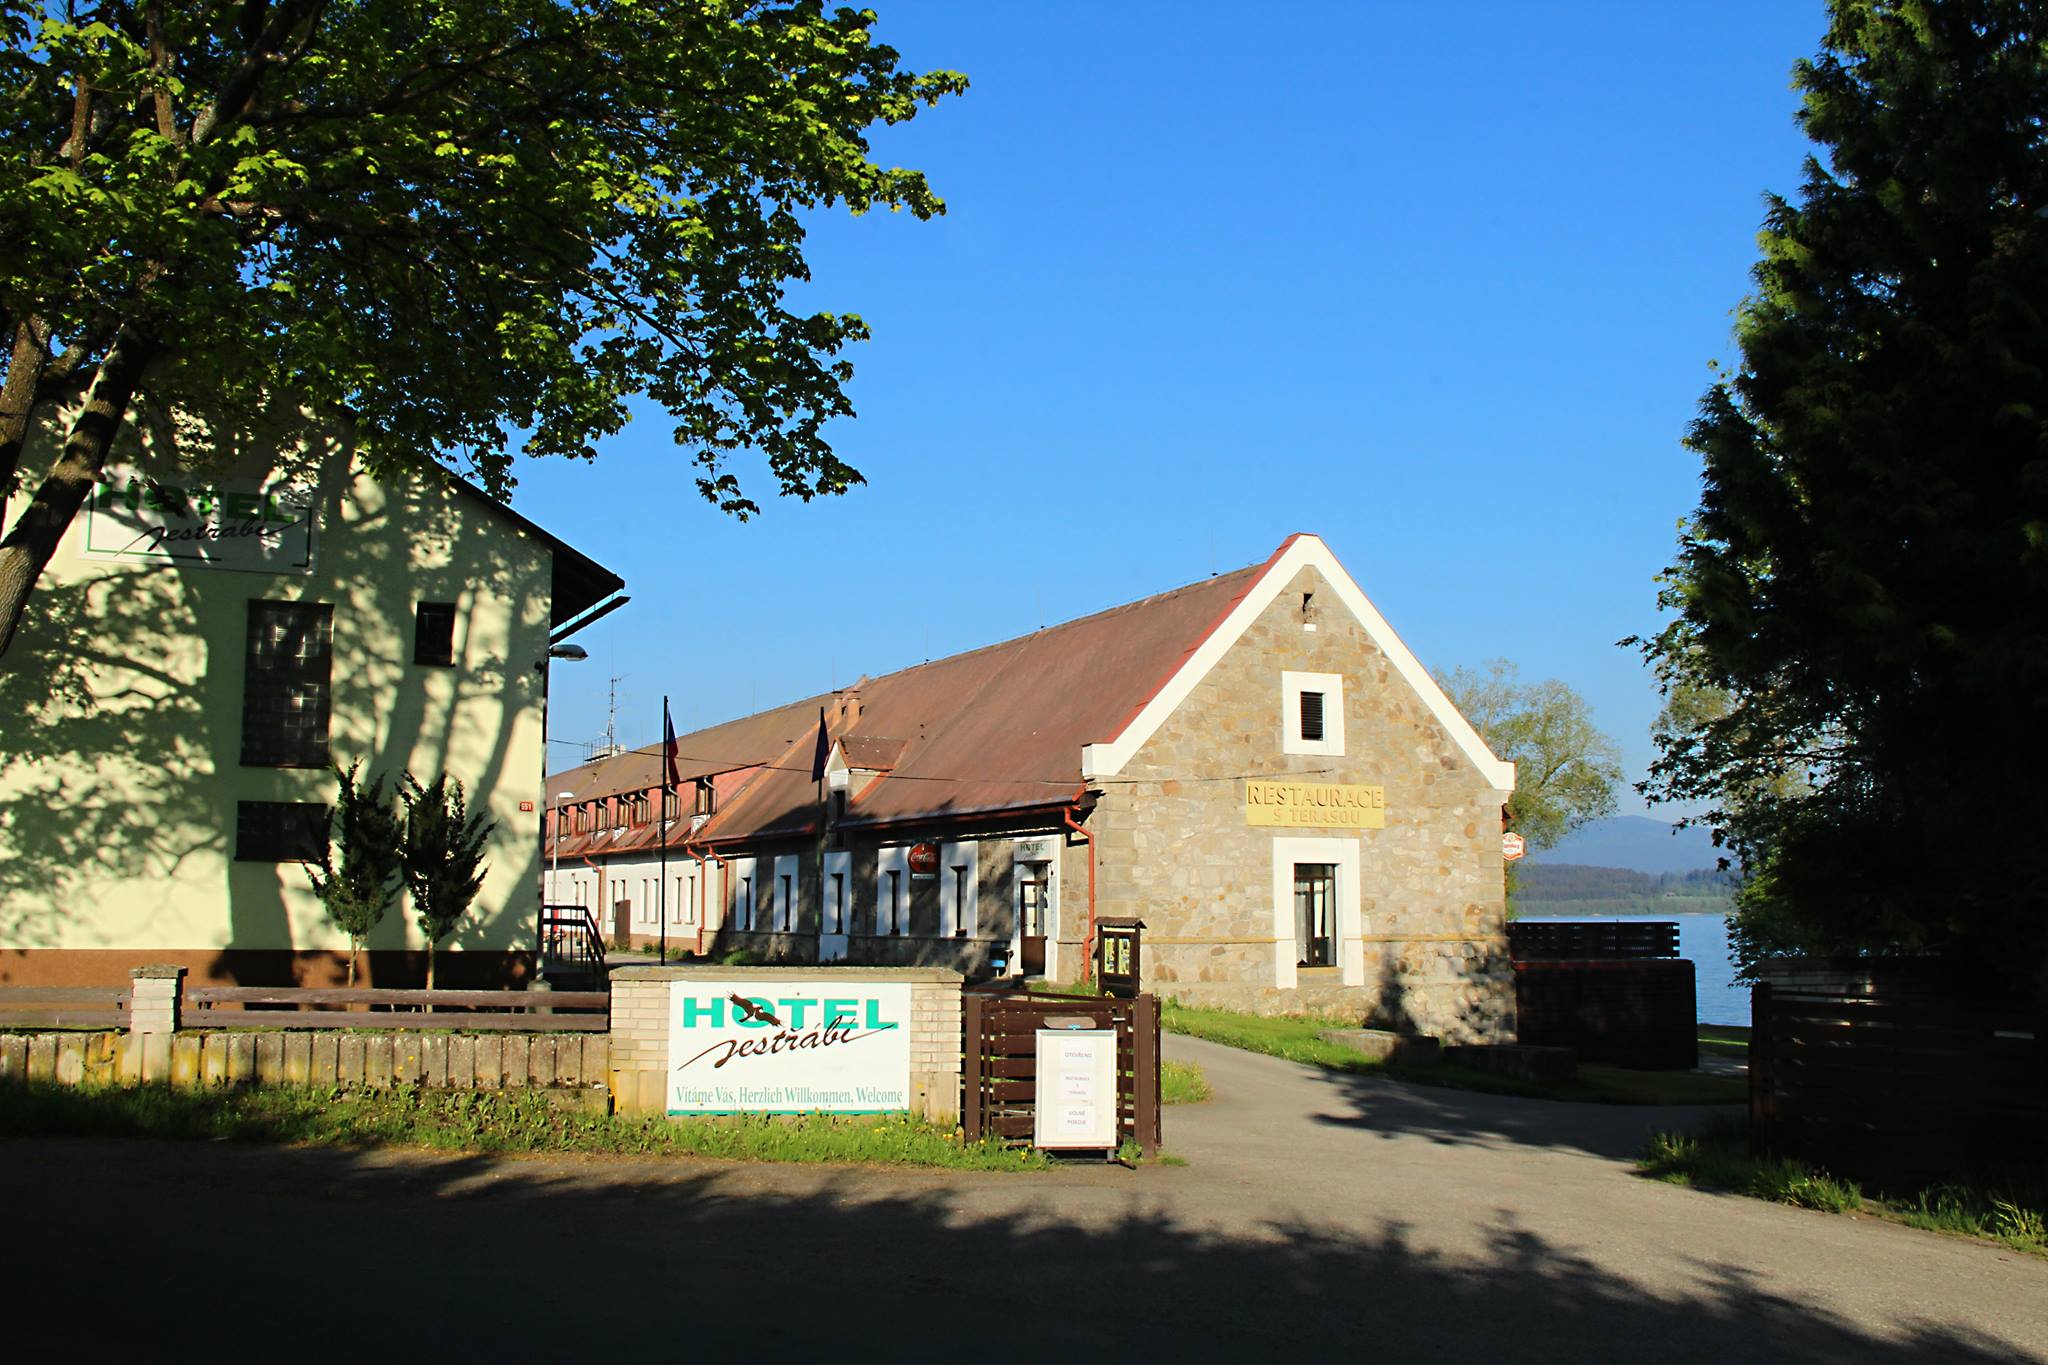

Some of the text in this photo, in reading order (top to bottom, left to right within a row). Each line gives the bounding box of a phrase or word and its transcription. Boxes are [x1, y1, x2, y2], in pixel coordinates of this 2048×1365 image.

[98, 482, 295, 523] HOTEL
[521, 802, 532, 810] 551
[1247, 785, 1383, 809] RESTAURACE
[1273, 808, 1361, 825] S TERASOU
[683, 997, 899, 1030] HOTEL
[675, 1086, 903, 1105] Vítáme Vás, Herzlich Willkommen, Welcome
